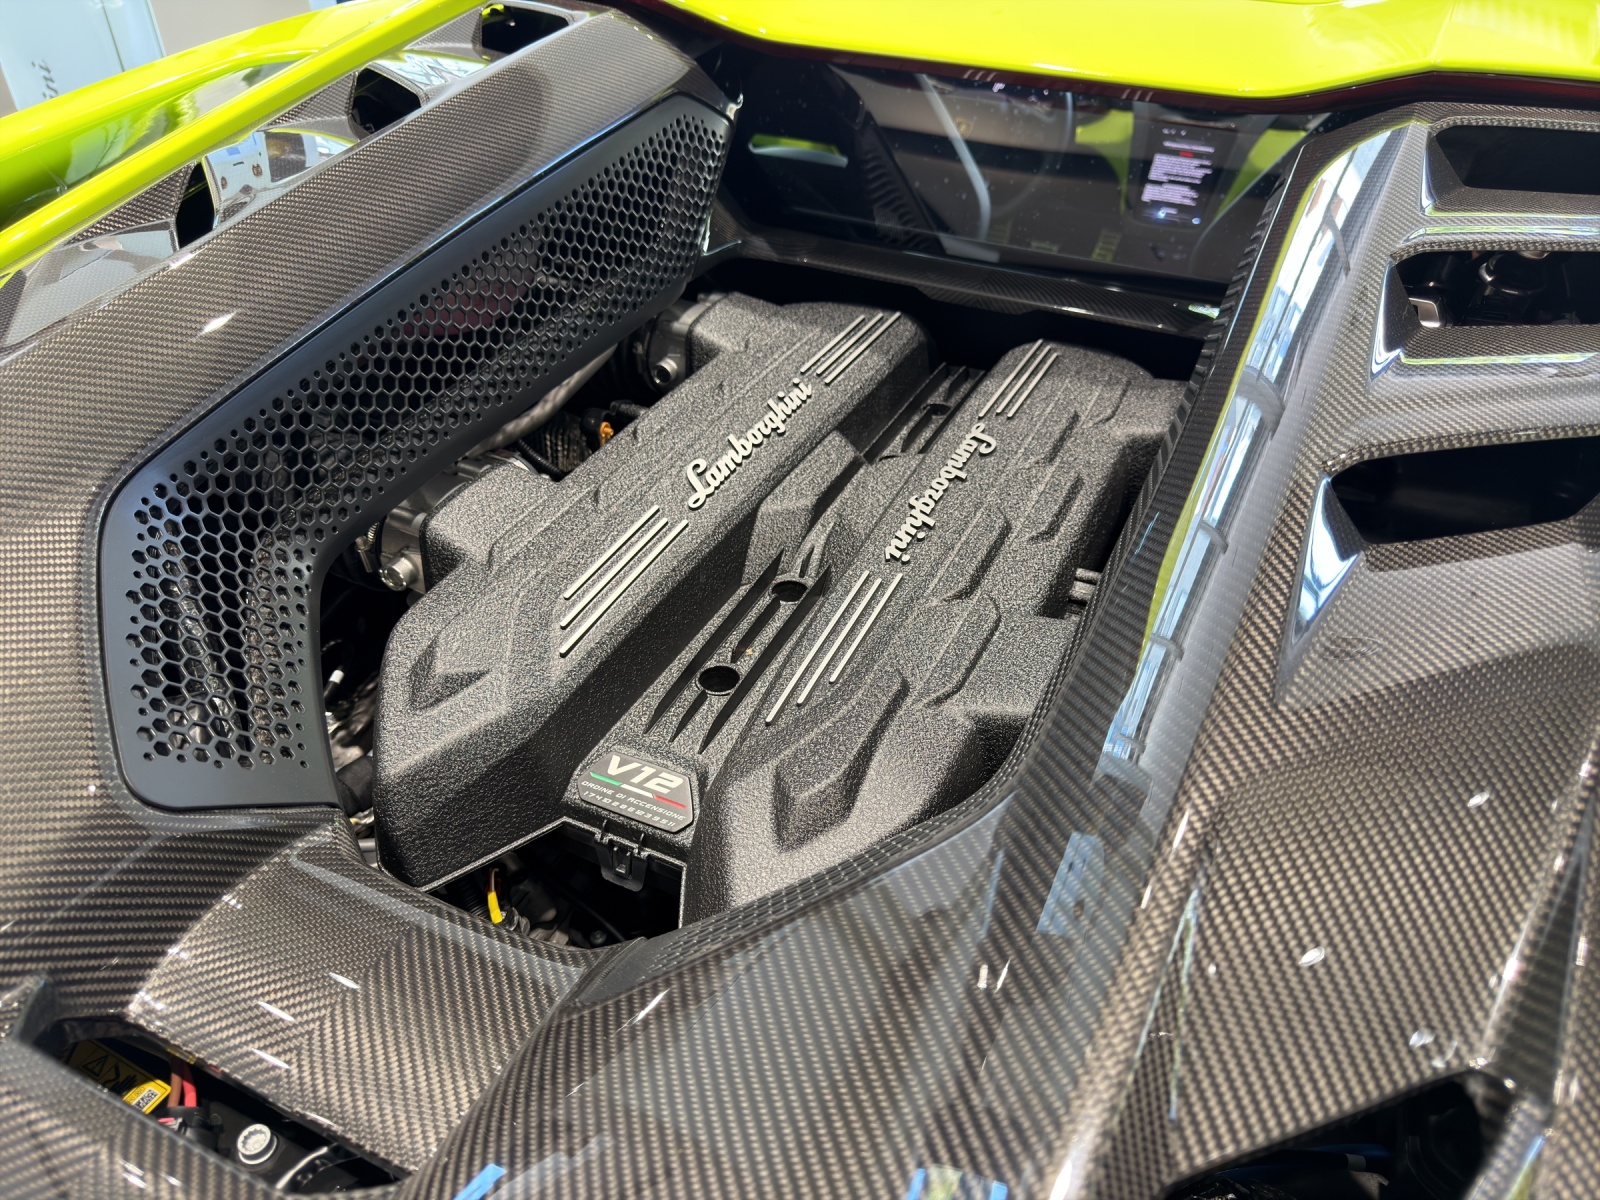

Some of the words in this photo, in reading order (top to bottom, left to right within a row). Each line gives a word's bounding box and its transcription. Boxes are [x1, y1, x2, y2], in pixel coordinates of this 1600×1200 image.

[685, 377, 814, 509] Lamborghini
[885, 422, 997, 563] Lamborghini
[581, 780, 614, 794] ORDINE
[627, 797, 686, 820] ACCENSIONE
[607, 754, 684, 794] V12
